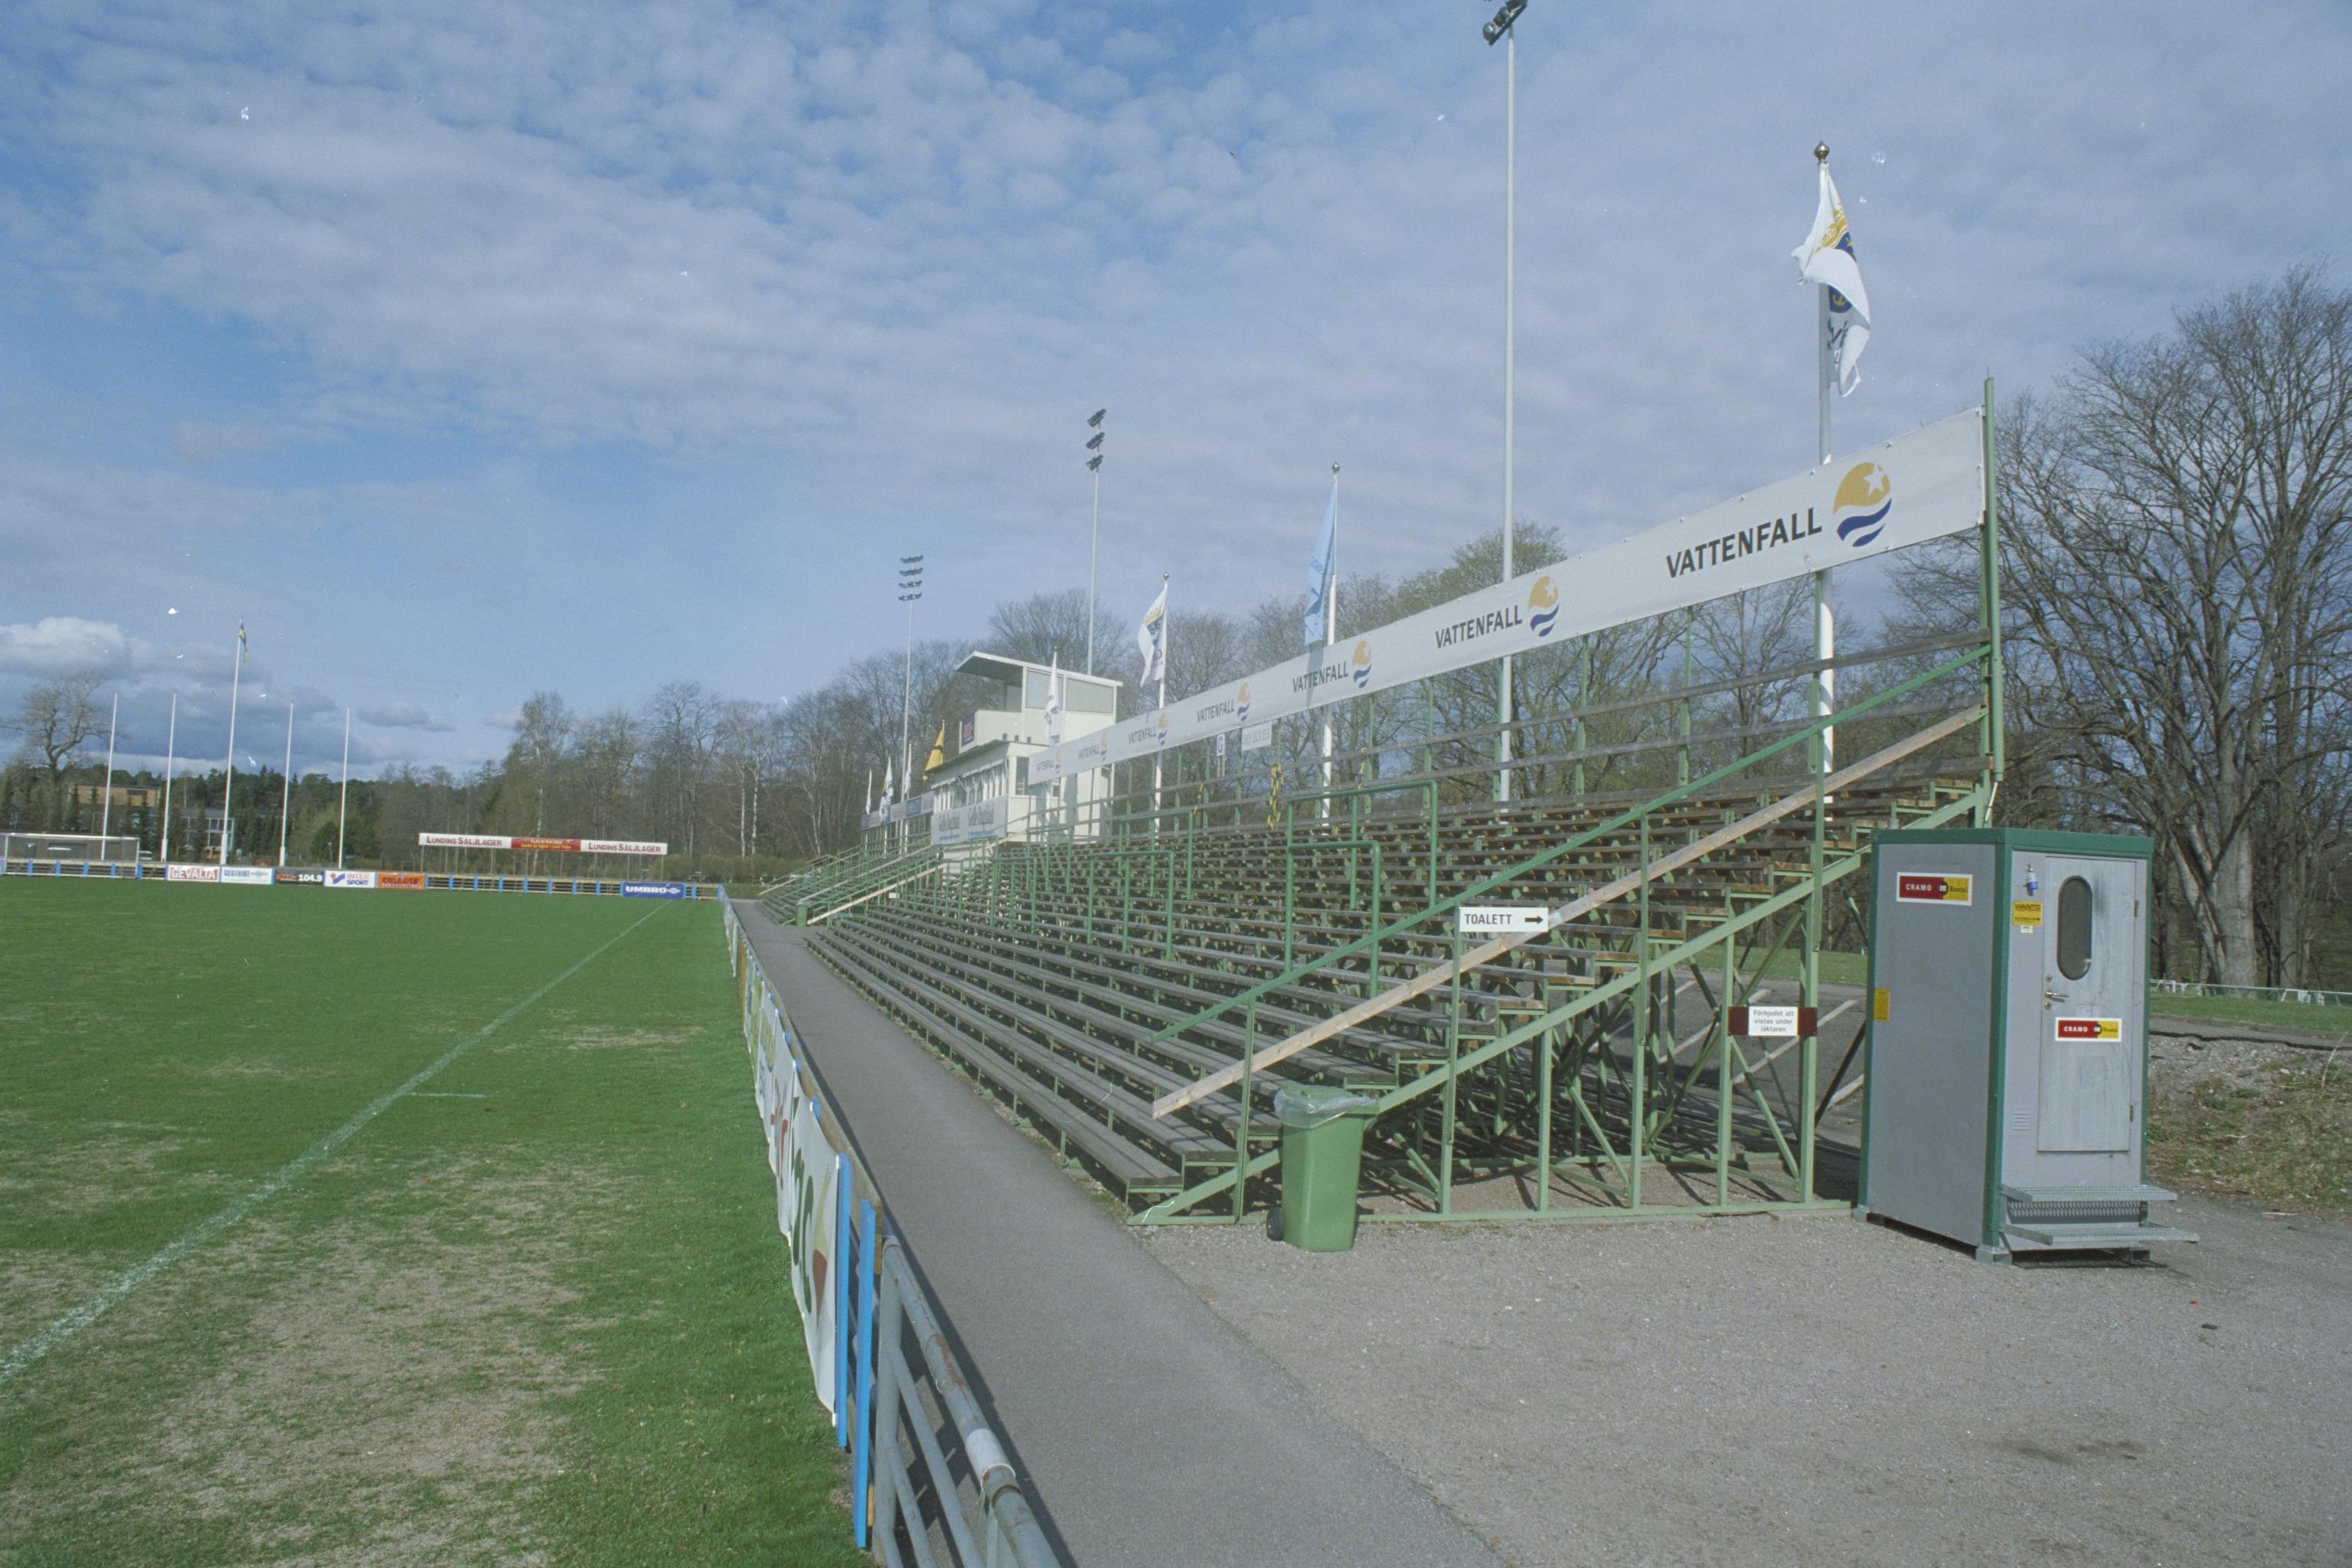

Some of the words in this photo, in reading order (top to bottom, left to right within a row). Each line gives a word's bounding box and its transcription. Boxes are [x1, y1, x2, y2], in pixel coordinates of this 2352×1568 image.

[1665, 507, 1823, 579] VATTENFALL
[1435, 604, 1523, 649] VATTENFALL
[1292, 661, 1349, 693] VATTENFALL
[1196, 698, 1236, 723] VATTENFALL
[1128, 727, 1158, 744] VATTENFALL
[426, 835, 457, 844] LUNDINS
[588, 842, 618, 851] LUNDINS
[298, 874, 323, 882] 104.9
[625, 885, 668, 894] UMBRO
[1905, 883, 1932, 892] CRAMO
[1464, 913, 1513, 925] TOALETT
[1753, 1009, 1783, 1018] Förbjudet
